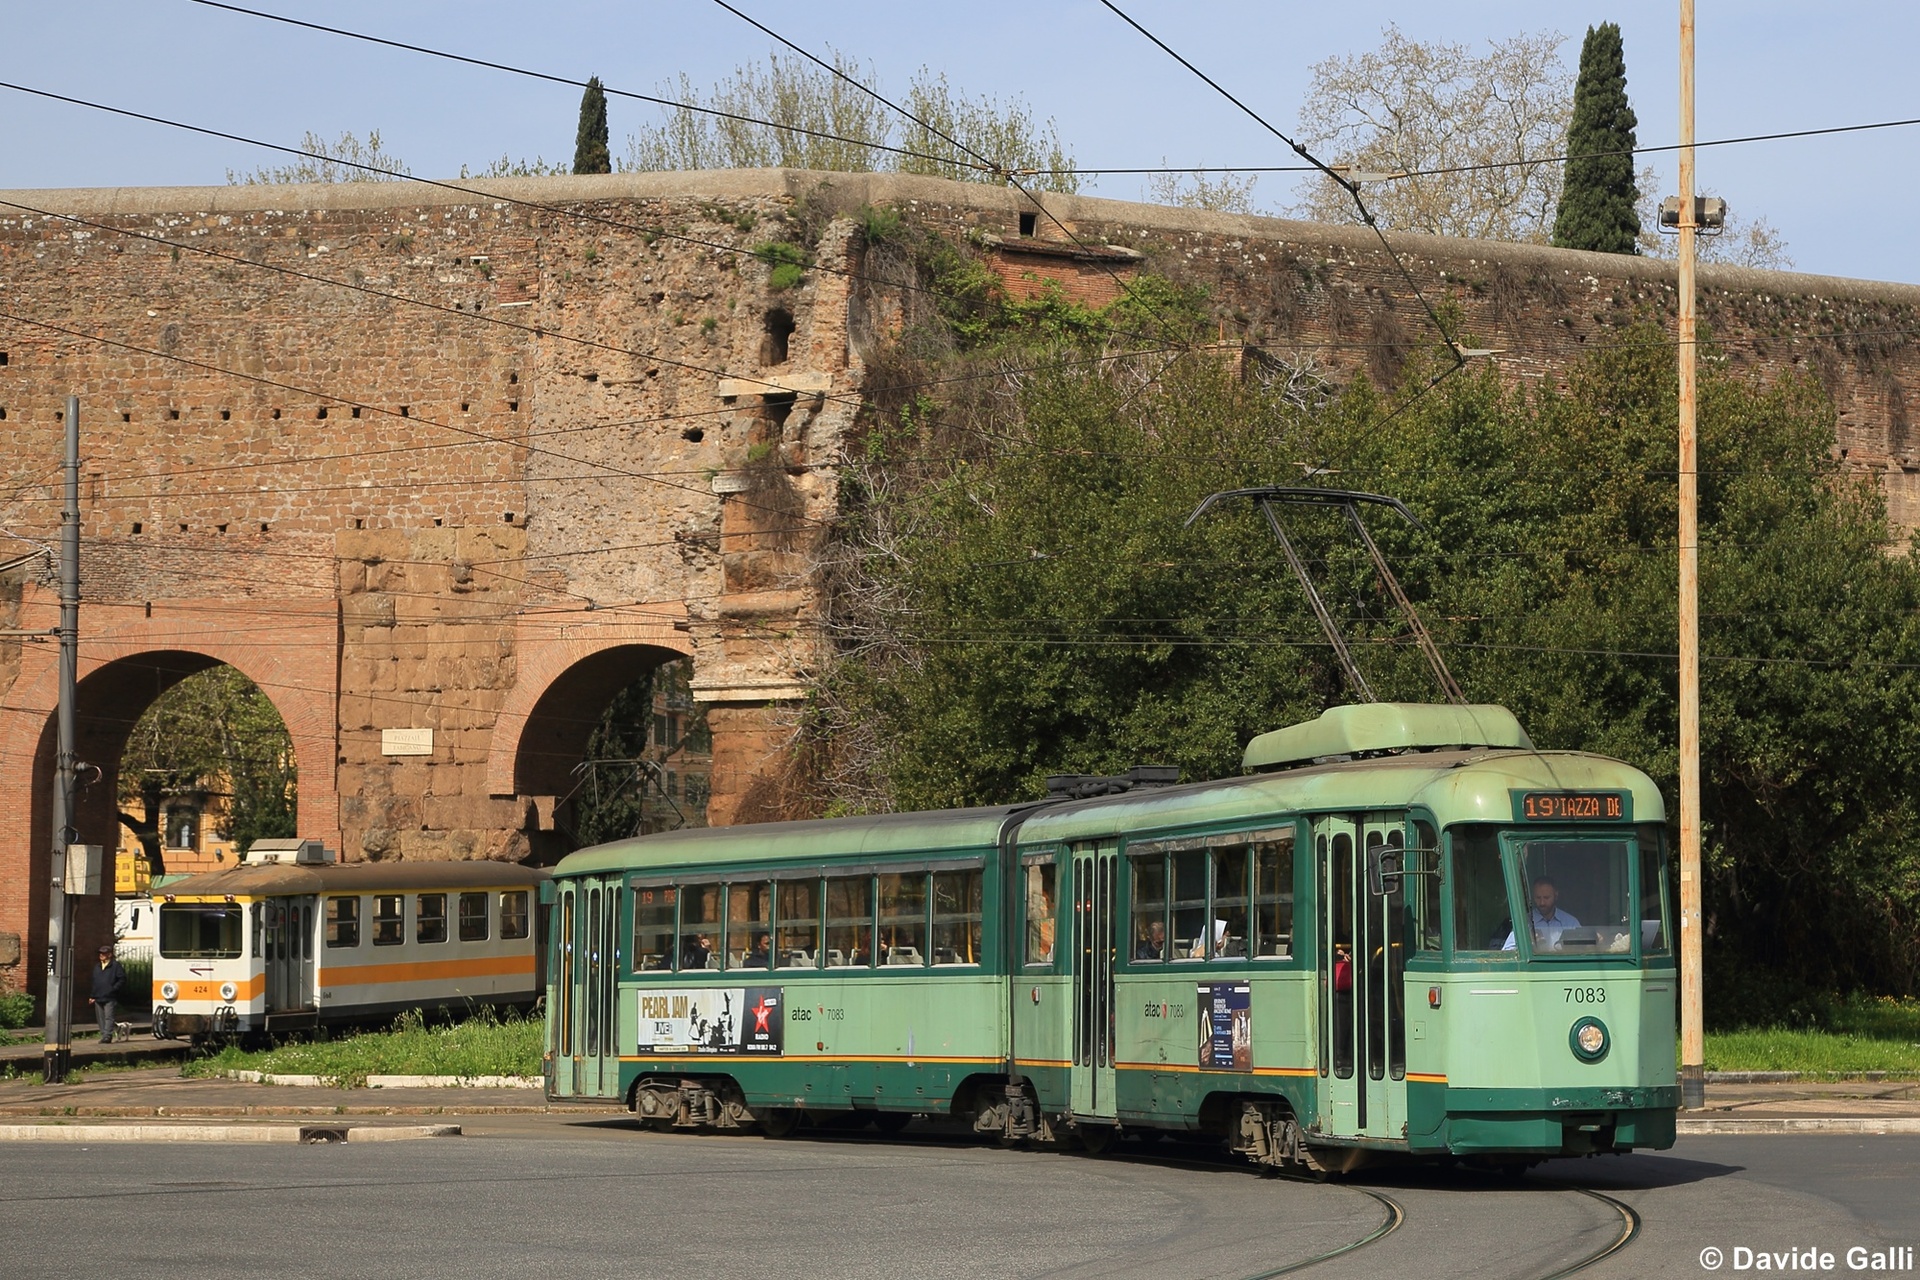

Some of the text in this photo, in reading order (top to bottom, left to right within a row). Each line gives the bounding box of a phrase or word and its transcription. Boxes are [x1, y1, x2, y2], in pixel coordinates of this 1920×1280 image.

[1526, 798, 1553, 816] 19
[642, 891, 653, 904] 19
[1563, 987, 1606, 1003] 7083
[642, 995, 688, 1019] PEARL JAM
[791, 1006, 845, 1021] atac 7083
[1144, 1001, 1184, 1018] atac 7083
[654, 1021, 670, 1034] LIVE
